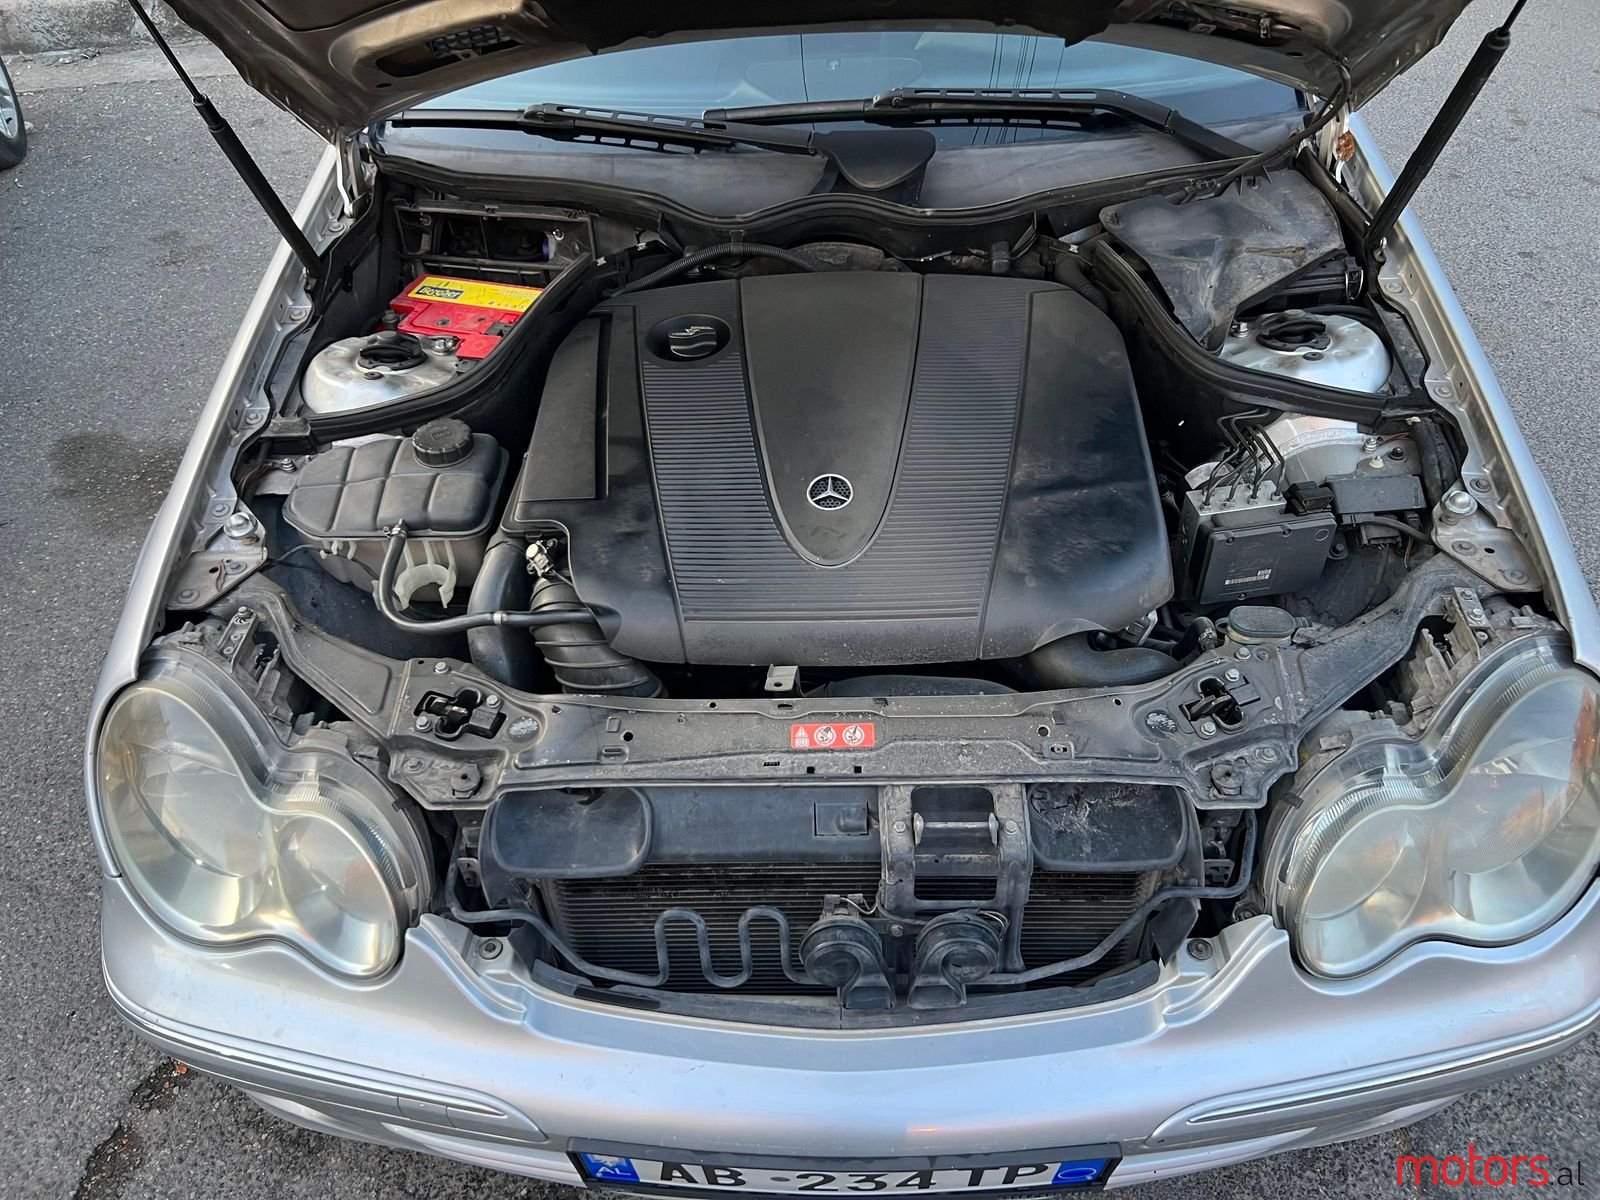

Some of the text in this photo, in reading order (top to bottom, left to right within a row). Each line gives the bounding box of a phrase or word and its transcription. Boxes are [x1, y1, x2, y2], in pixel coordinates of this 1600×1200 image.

[598, 1166, 632, 1176] AL
[660, 1161, 1049, 1192] AB 234 TP
